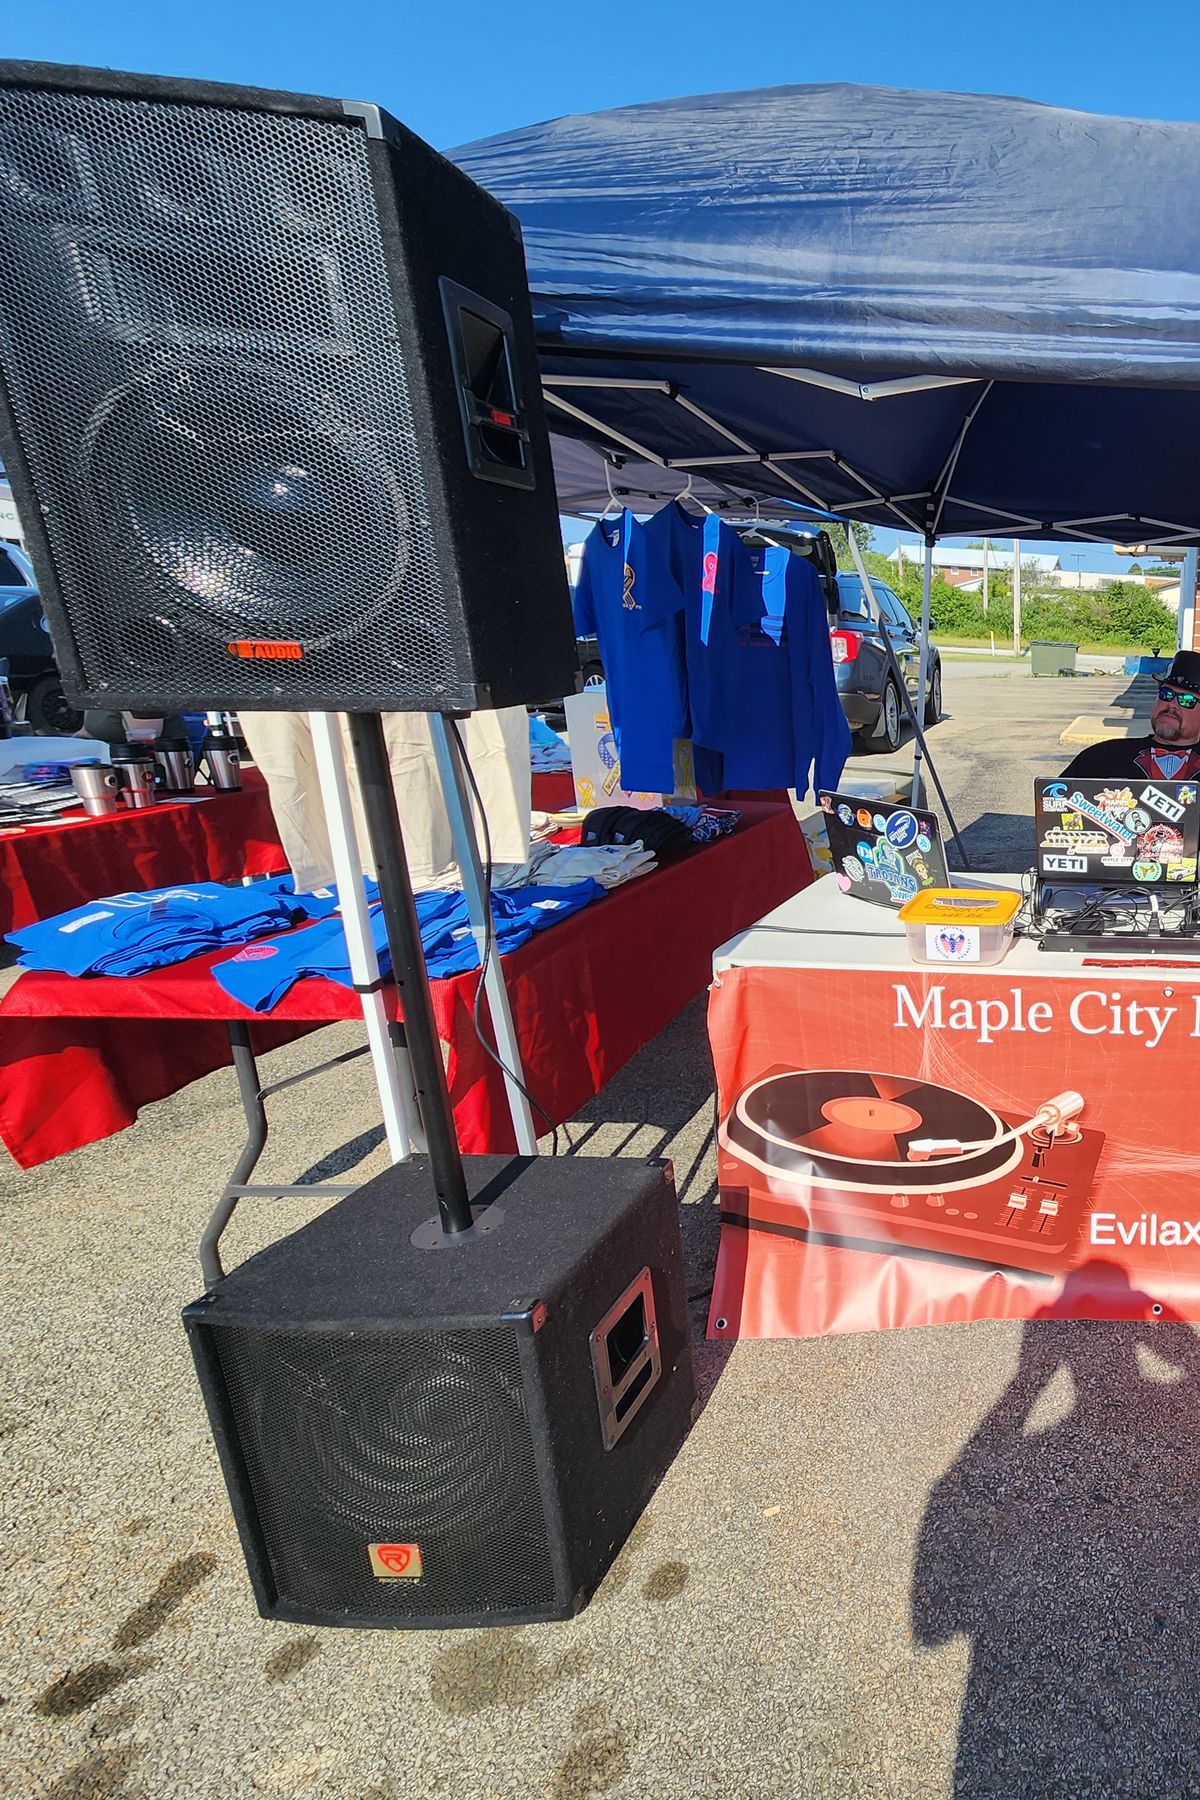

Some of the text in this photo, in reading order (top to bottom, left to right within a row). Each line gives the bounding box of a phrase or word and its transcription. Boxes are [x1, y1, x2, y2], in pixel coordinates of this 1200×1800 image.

[255, 643, 303, 659] AUDIO
[1146, 789, 1181, 818] YETI
[1071, 793, 1134, 841] Sweetwater
[1046, 858, 1084, 870] YETI
[869, 866, 915, 891] TROJANS
[924, 904, 992, 913] DONATE
[892, 984, 1053, 1043] Maple
[1069, 990, 1177, 1048] City
